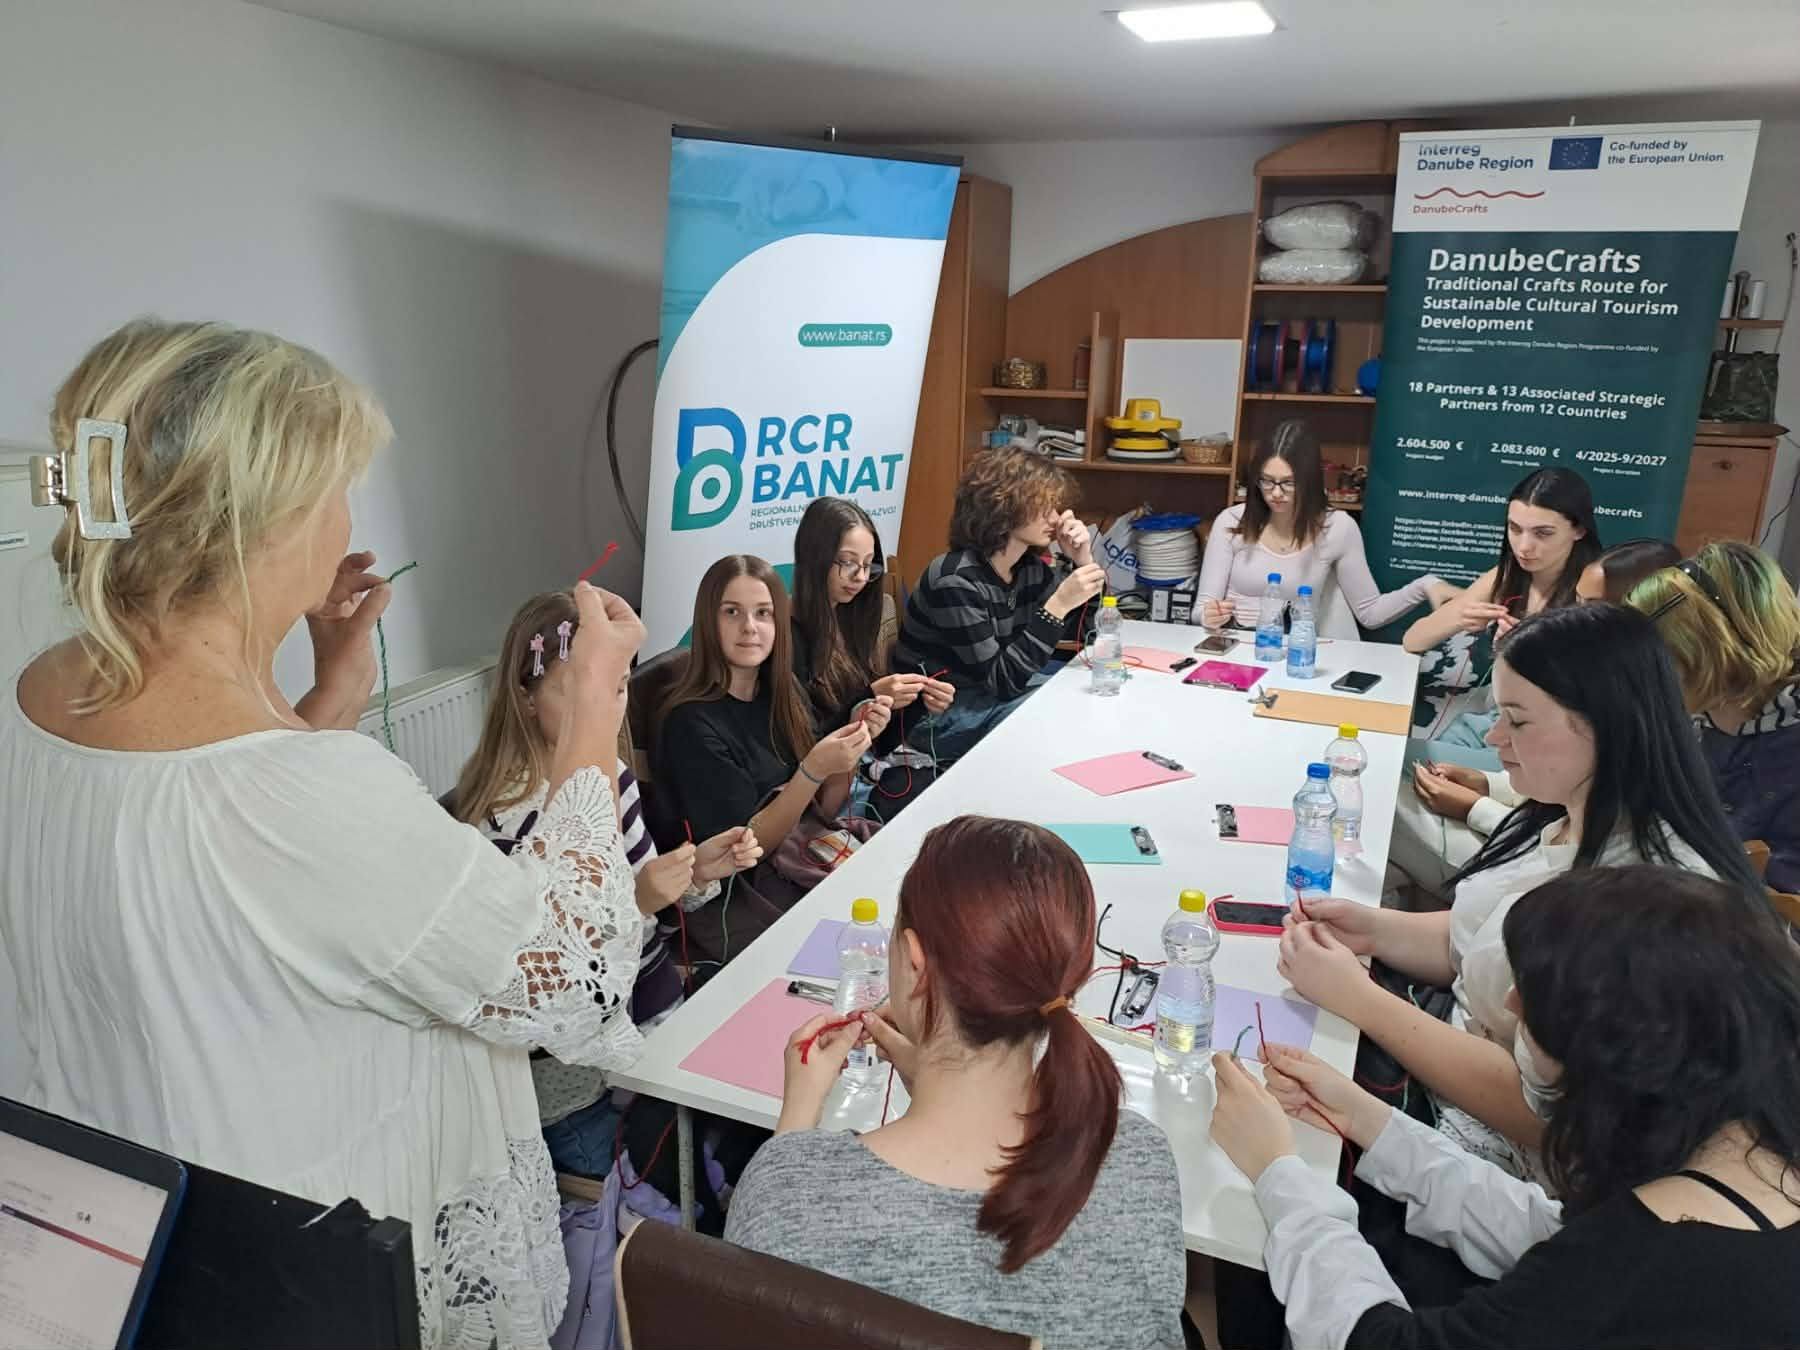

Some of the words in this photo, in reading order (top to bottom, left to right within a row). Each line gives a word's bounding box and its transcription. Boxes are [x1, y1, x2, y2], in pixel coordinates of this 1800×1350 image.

[1418, 144, 1481, 157] Interreg
[1609, 140, 1671, 151] Co-funded
[1673, 139, 1688, 150] by
[1417, 158, 1475, 171] Danube
[1479, 157, 1534, 172] Region
[1608, 155, 1625, 165] the
[1629, 154, 1685, 165] European
[1688, 152, 1724, 162] Union
[1413, 204, 1488, 214] DanubeCrafts
[1429, 248, 1641, 273] DanubeCrafts
[1426, 276, 1519, 291] Traditional
[1523, 277, 1576, 293] Crafts
[1580, 279, 1635, 294] Route
[1639, 279, 1669, 294] for
[1423, 296, 1522, 311] Sustainable
[1526, 298, 1598, 313] Cultural
[1602, 299, 1679, 315] Tourism
[1421, 315, 1535, 333] Development
[802, 327, 888, 342] www.banat.rs
[1408, 382, 1423, 393] 18
[1426, 382, 1485, 395] Partners
[1487, 384, 1498, 396] &
[1502, 385, 1518, 397] 13
[1519, 386, 1596, 402] Associated
[1598, 391, 1666, 409] Strategic
[1440, 398, 1499, 411] Partners
[1502, 399, 1535, 413] from
[1539, 403, 1555, 415] 12
[1557, 404, 1627, 420] Countries
[756, 413, 853, 457] RCR
[1396, 437, 1450, 450] 2.604.500
[1456, 441, 1464, 450] €
[1490, 443, 1547, 456] 2.083.600
[1552, 448, 1560, 458] €
[1575, 450, 1667, 466] 4/2025-9/2027
[752, 453, 904, 503] BANAT
[749, 517, 800, 530] DRUŠTVEN
